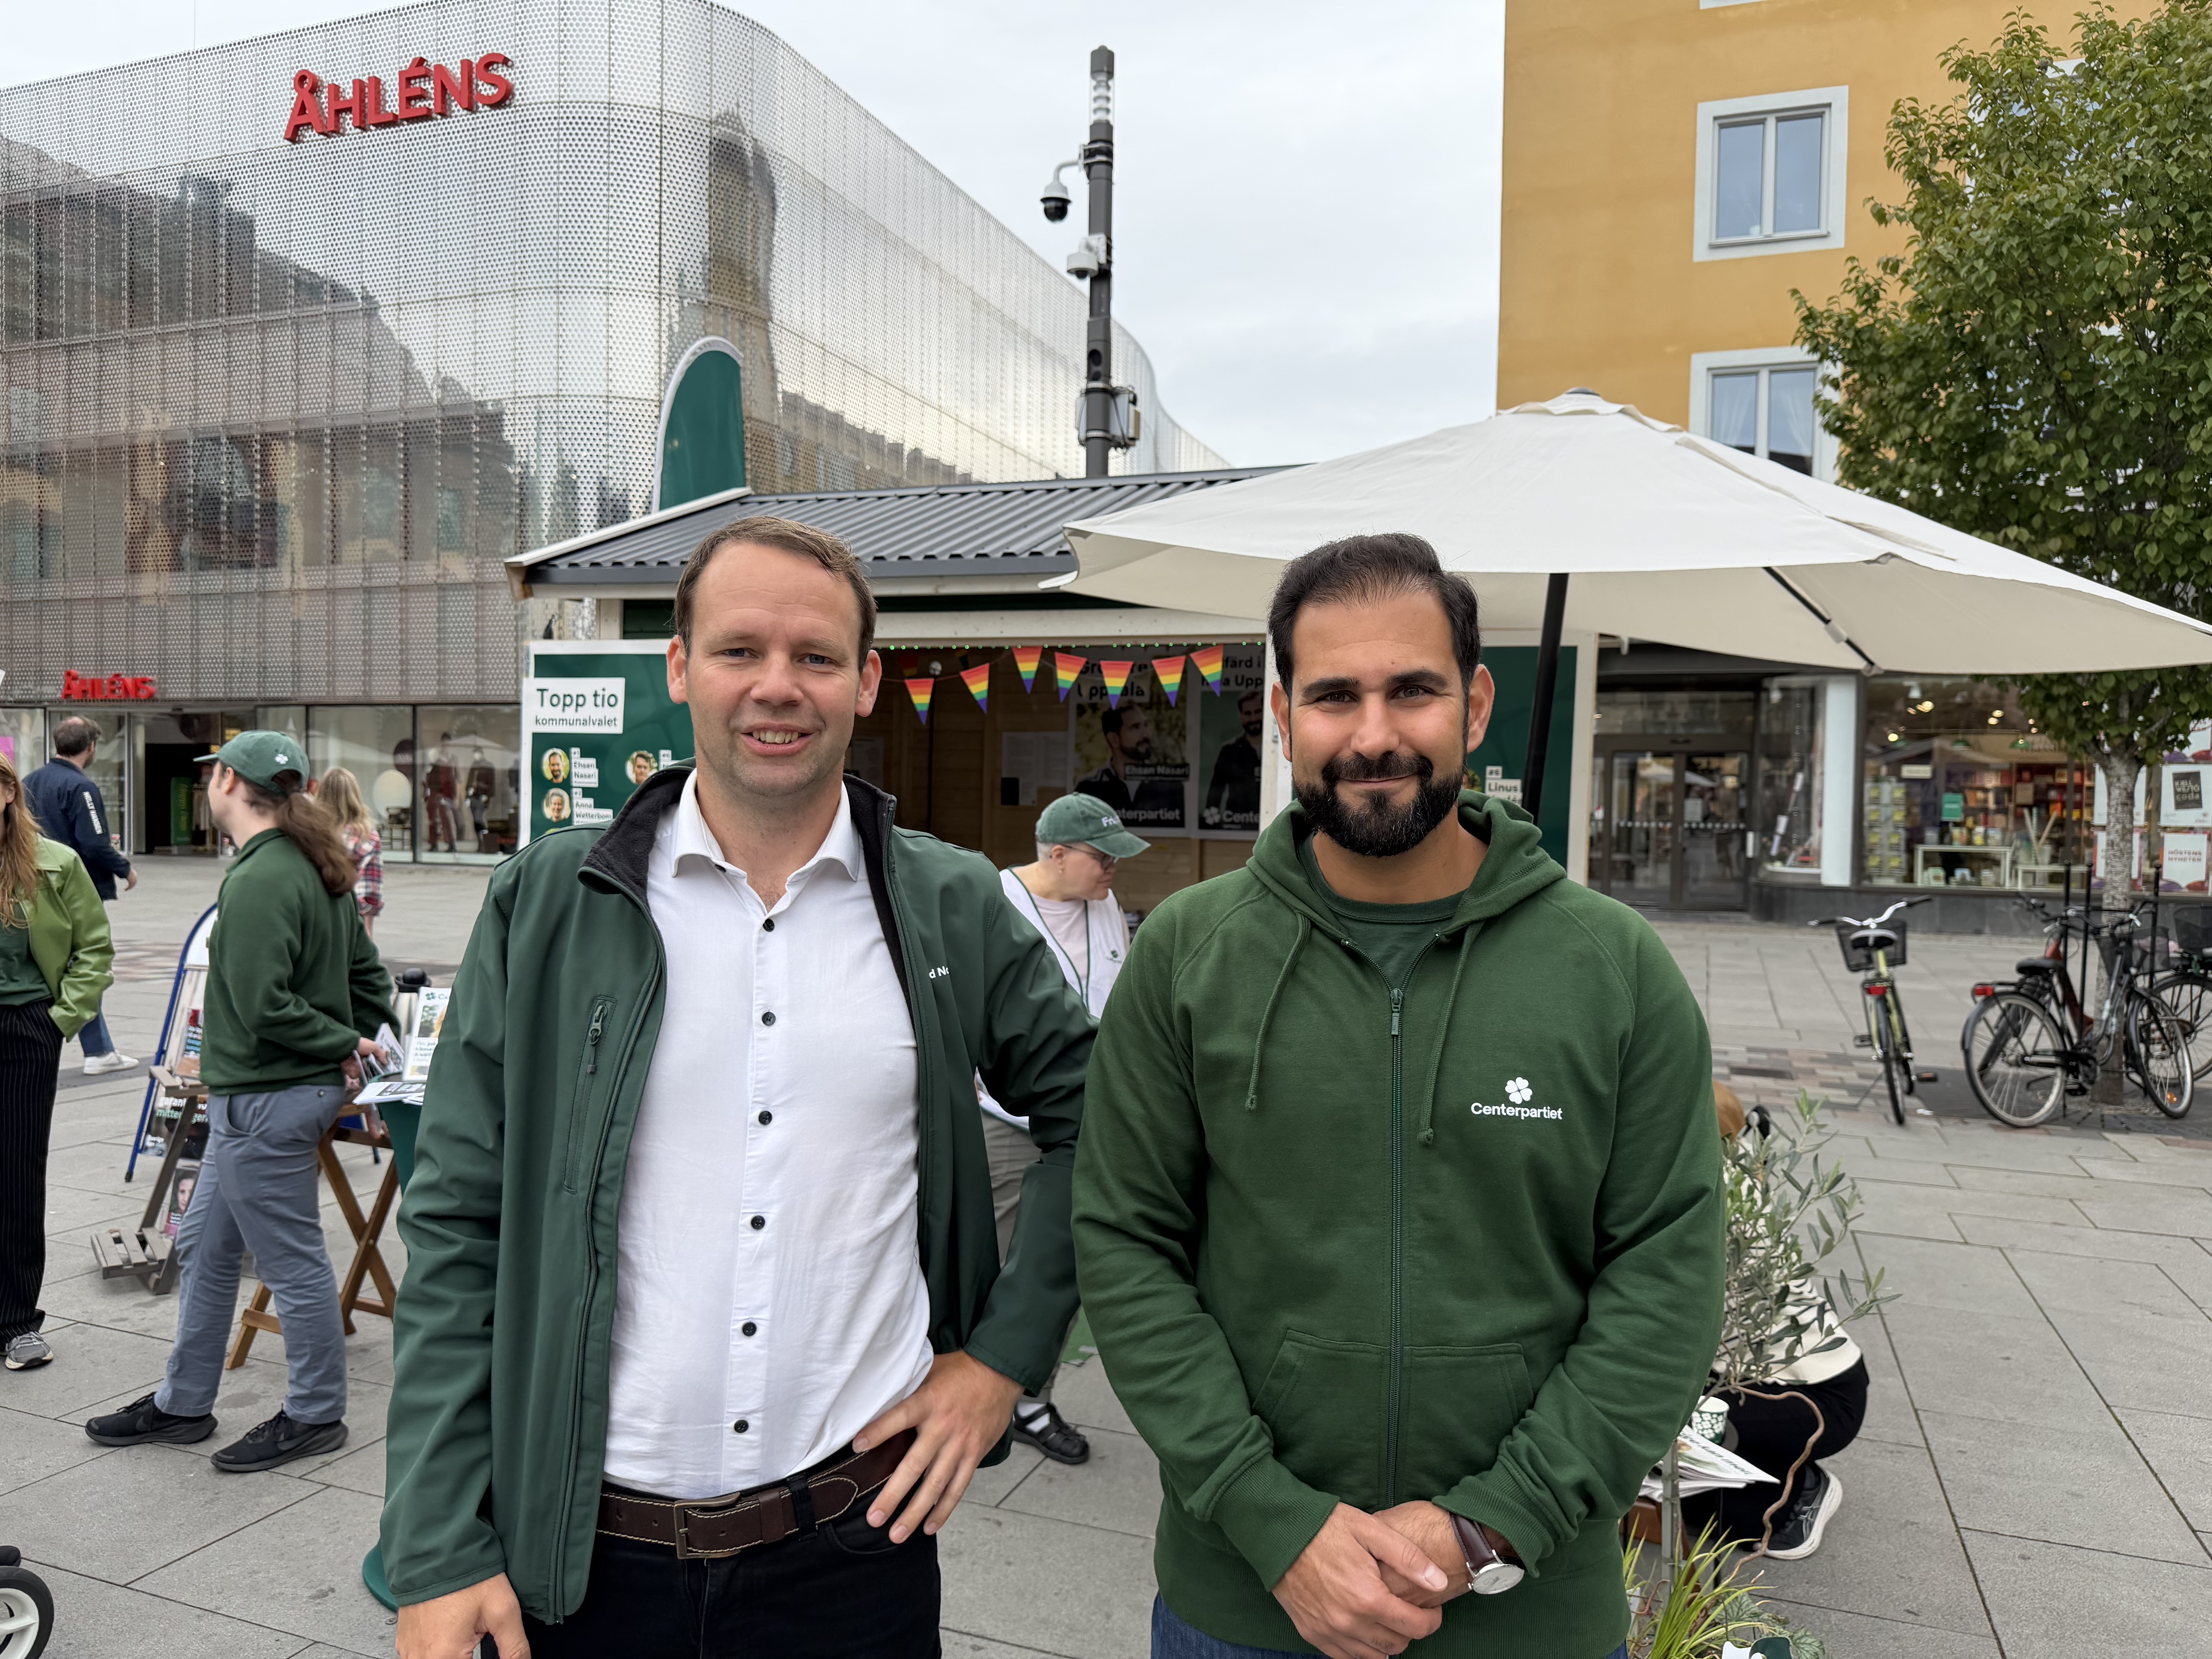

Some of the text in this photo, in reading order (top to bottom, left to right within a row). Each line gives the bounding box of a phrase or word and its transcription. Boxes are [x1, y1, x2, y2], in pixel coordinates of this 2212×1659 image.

[283, 53, 514, 142] ÅHLÉNS
[61, 669, 156, 699] ÅHLÉNS
[536, 687, 618, 713] Topp tio
[535, 714, 618, 726] kommunalvalet
[1488, 781, 1518, 792] Linus
[1116, 807, 1181, 822] nterpartiet
[929, 966, 950, 979] d N
[1471, 1102, 1563, 1120] Centerpartiet
